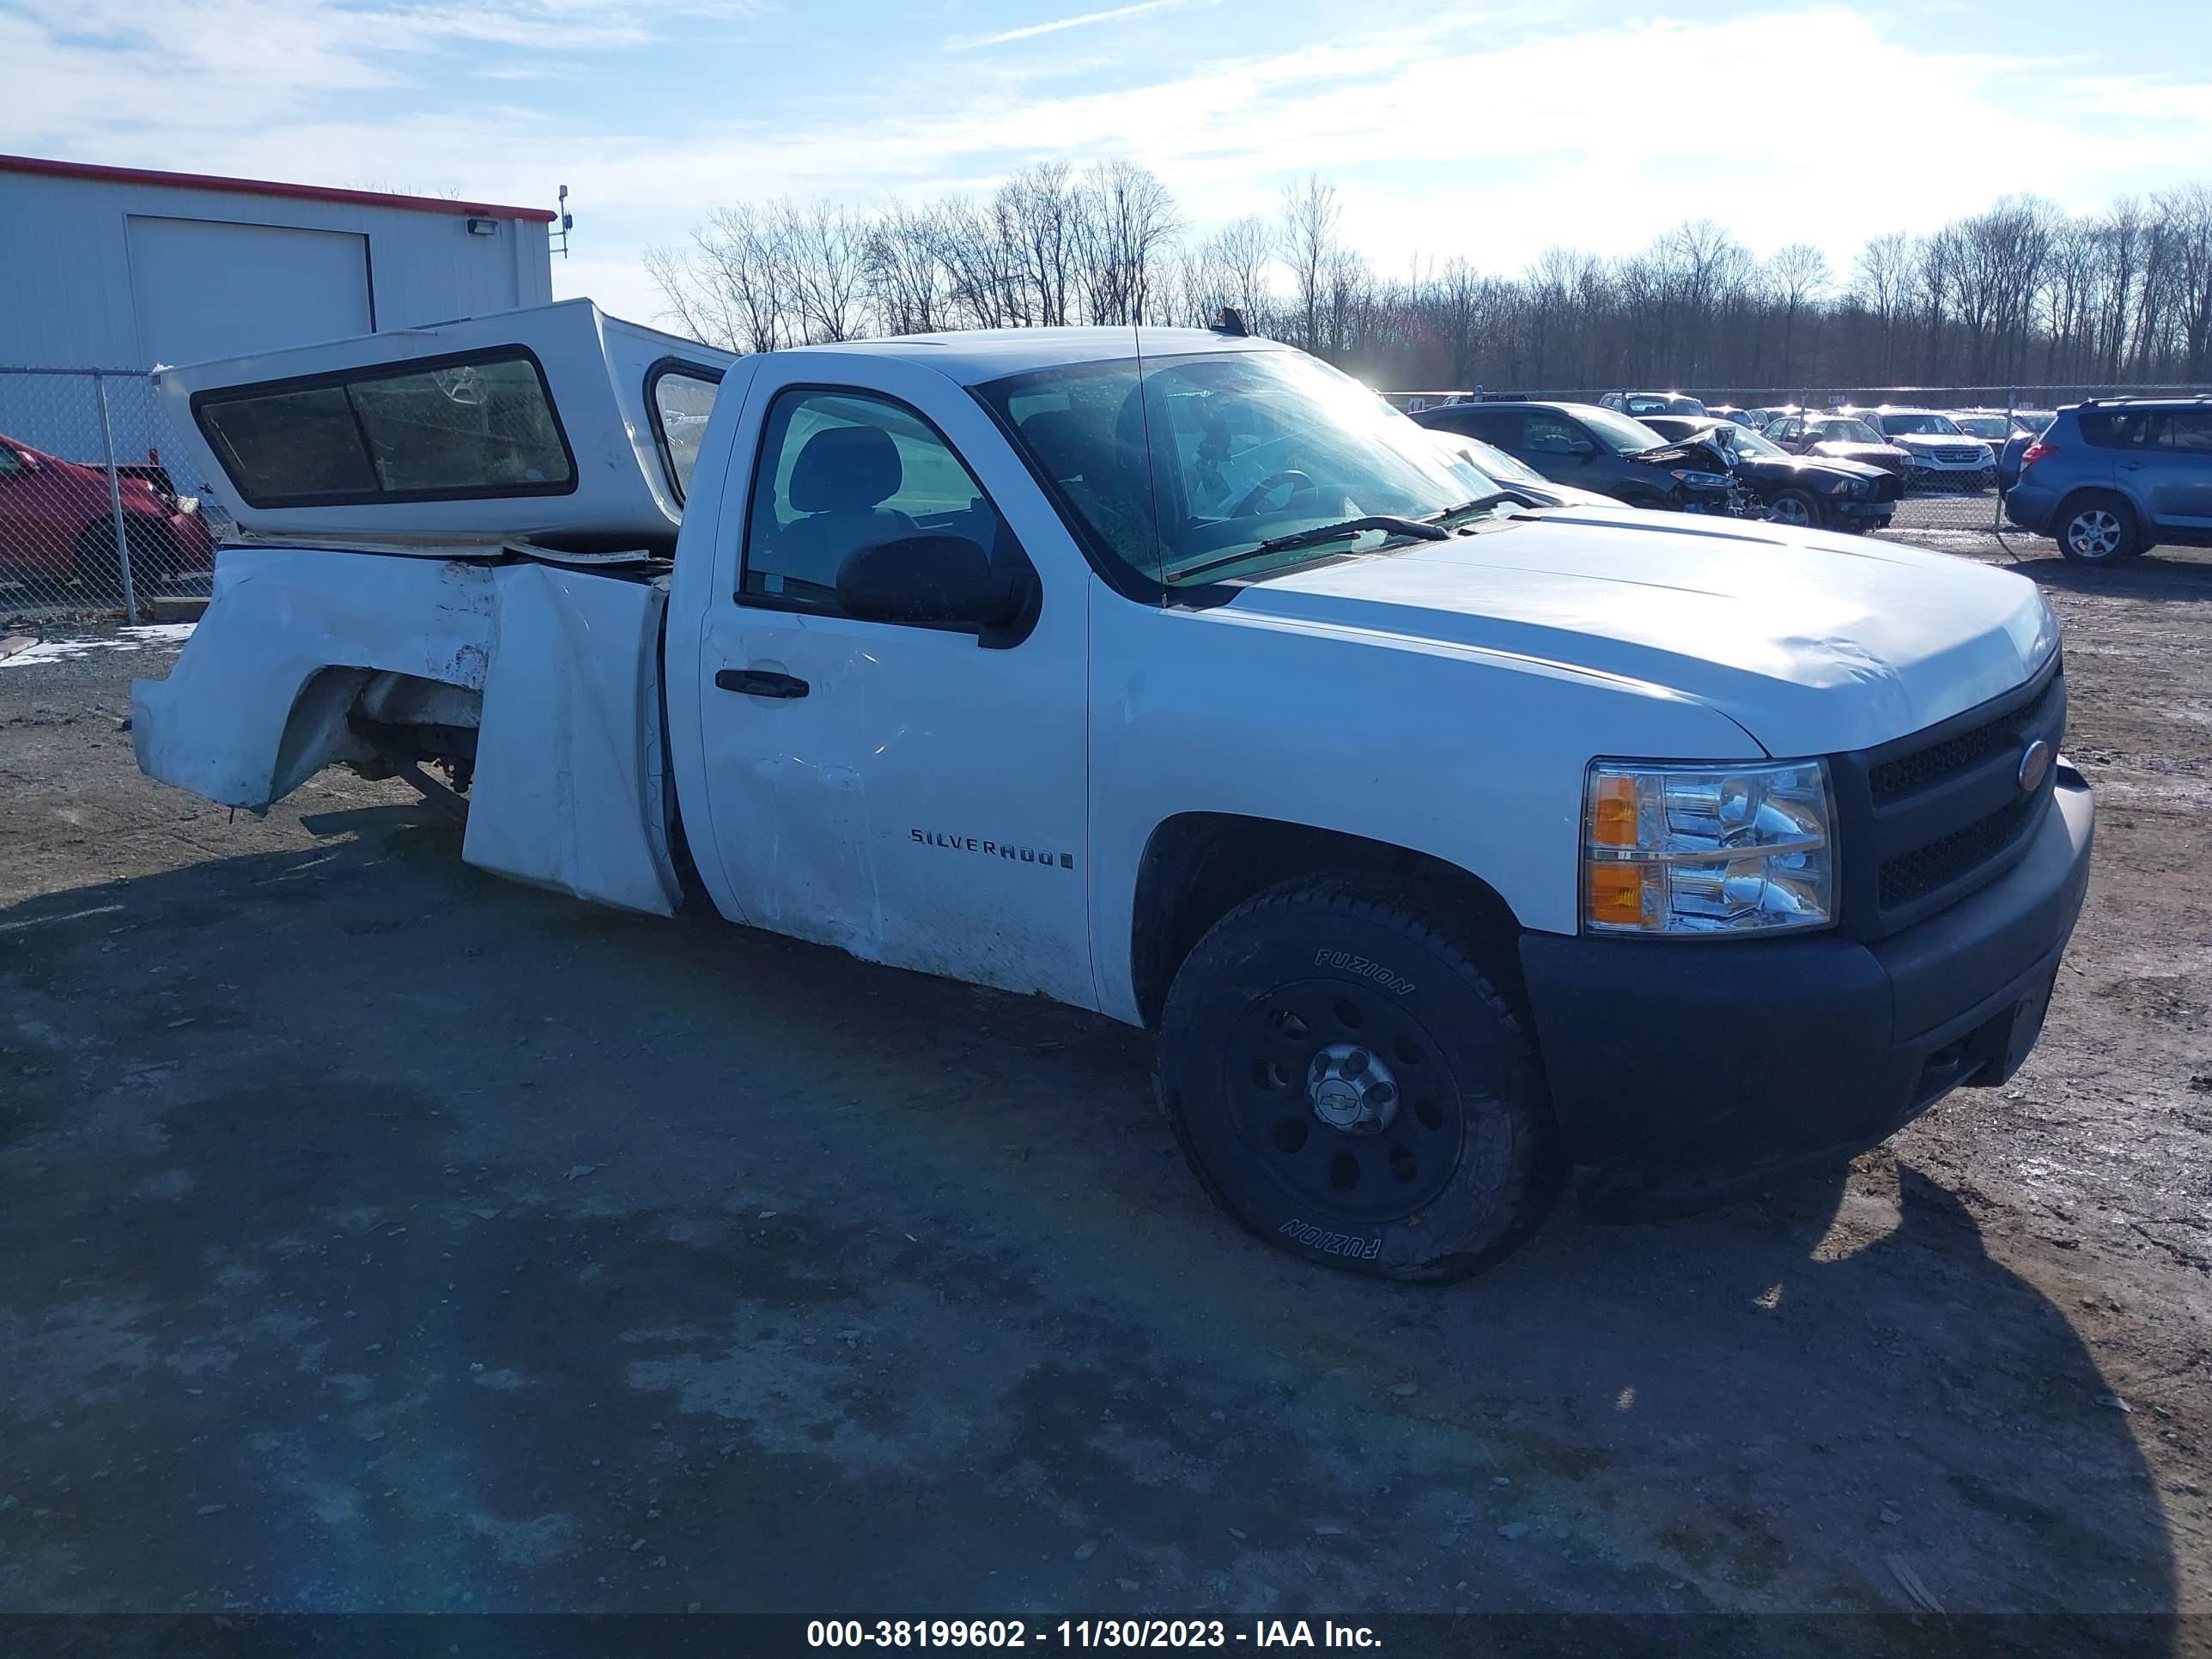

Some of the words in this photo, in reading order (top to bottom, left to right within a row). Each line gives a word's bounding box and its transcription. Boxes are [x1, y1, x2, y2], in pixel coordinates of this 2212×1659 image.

[910, 828, 1054, 866] SILVERADO
[1314, 948, 1416, 995] FUZION
[1279, 1218, 1382, 1260] FUZION
